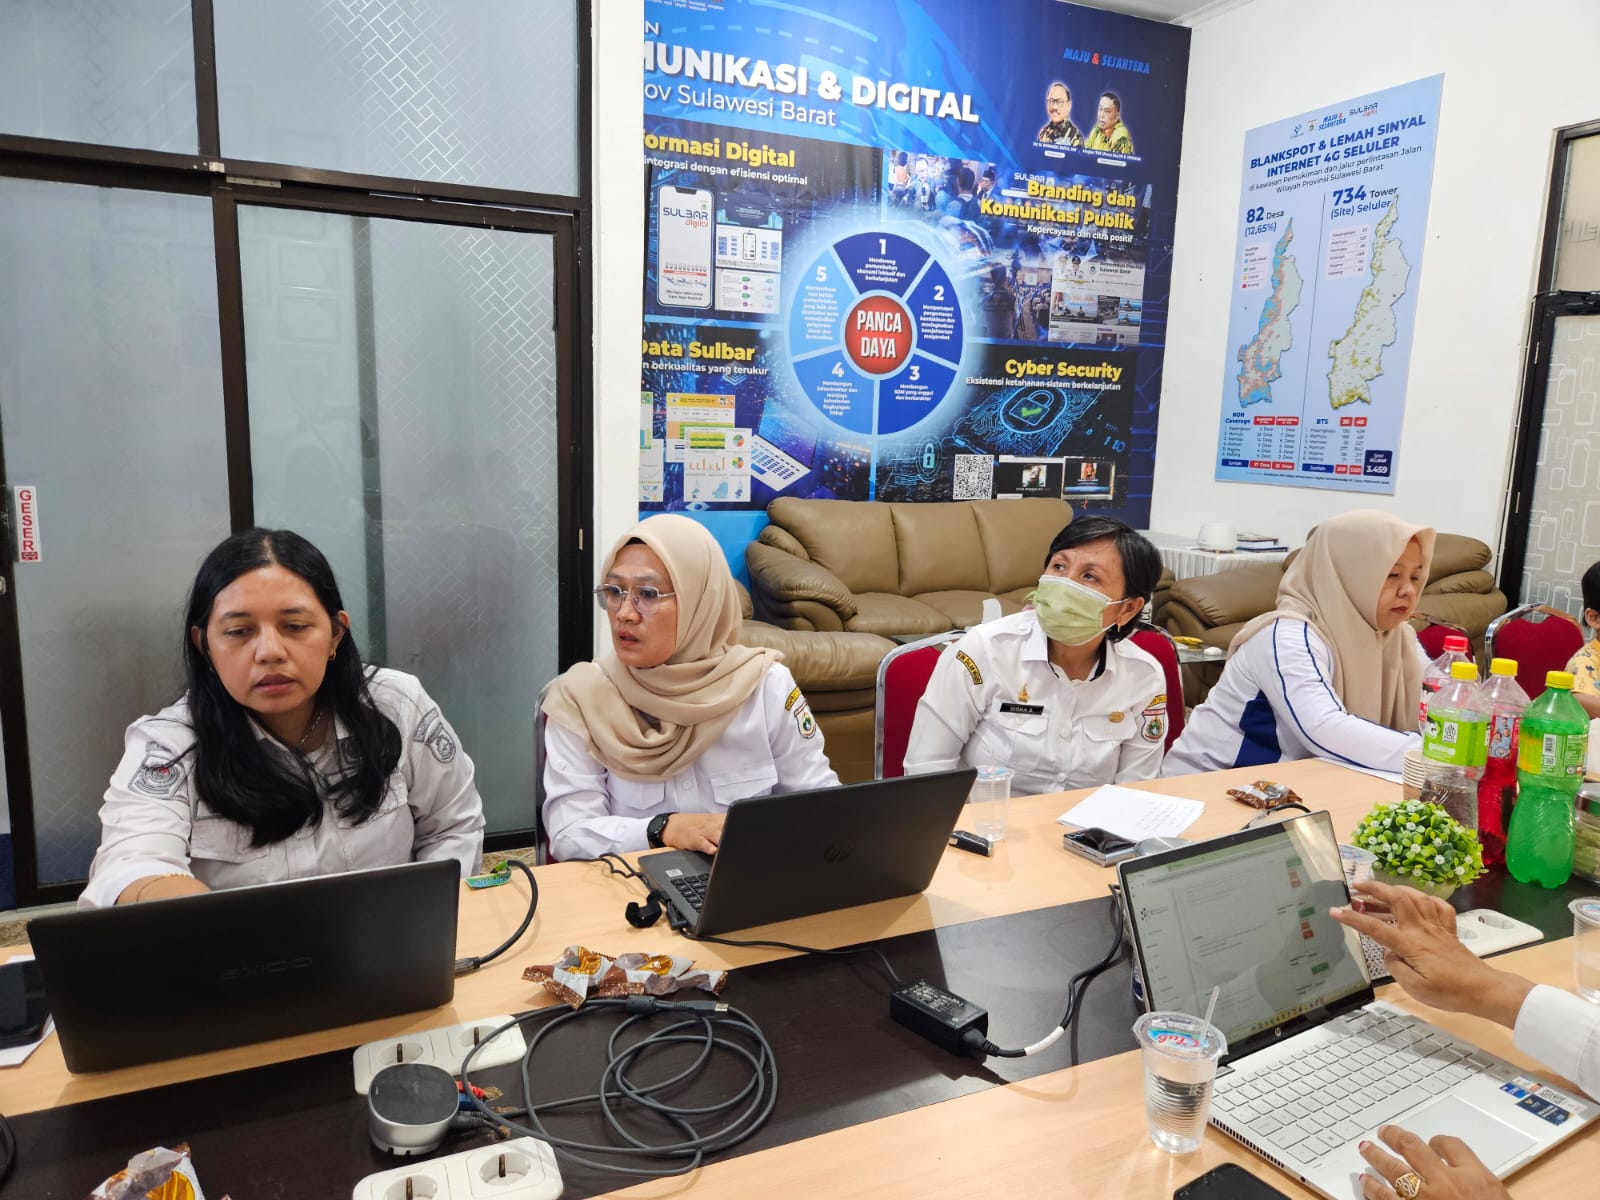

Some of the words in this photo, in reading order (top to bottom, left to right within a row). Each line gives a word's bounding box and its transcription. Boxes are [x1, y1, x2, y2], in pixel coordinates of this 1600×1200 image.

[644, 21, 660, 35] N
[1063, 48, 1090, 63] MAJU
[1091, 53, 1100, 65] &
[1101, 55, 1150, 75] SEJAHTERA
[644, 84, 671, 101] ov
[677, 85, 773, 117] Sulawesi
[782, 101, 836, 126] Barat
[817, 71, 842, 101] &
[852, 76, 979, 123] DIGITAL
[1250, 140, 1314, 169] BLANKSPOT
[1318, 139, 1326, 150] &
[1330, 127, 1374, 147] LEMAH
[1377, 114, 1426, 136] SINYAL
[726, 142, 796, 168] Digital
[1266, 155, 1321, 178] INTERNET
[1323, 151, 1340, 164] 4G
[1343, 136, 1400, 159] SELULER
[1284, 168, 1322, 184] Pemukiman
[1324, 164, 1337, 174] dan
[1400, 145, 1422, 157] Jalan
[690, 161, 728, 175] dengan
[731, 166, 770, 181] efisiensi
[772, 171, 808, 185] optimal
[1276, 182, 1301, 194] Wilayah
[1302, 176, 1329, 189] Provinsi
[1330, 168, 1362, 181] Sulawesi
[1363, 163, 1384, 174] Barat
[1028, 180, 1103, 207] Branding
[1107, 190, 1136, 208] dan
[1332, 184, 1367, 206] 734
[1370, 185, 1398, 199] Tower
[980, 198, 1079, 225] Komunikasi
[1083, 210, 1135, 230] Publik
[1246, 207, 1264, 223] 82
[1266, 210, 1285, 219] Desa
[1330, 204, 1354, 220] (Site)
[1357, 199, 1391, 214] Seluler
[1027, 224, 1075, 237] Kepercayaan
[1077, 230, 1091, 239] dan
[1093, 231, 1109, 241] citra
[1110, 234, 1133, 244] positif
[879, 239, 887, 255] 1
[816, 266, 827, 282] 5
[934, 286, 944, 301] 2
[857, 310, 902, 333] PANCA
[689, 341, 755, 361] Sulbar
[861, 337, 896, 358] DAYA
[653, 361, 706, 372] berkualitas
[708, 365, 731, 375] yang
[734, 366, 768, 375] terukur
[831, 362, 844, 377] 4
[909, 366, 920, 380] 3
[1005, 359, 1053, 378] Cyber
[1057, 362, 1122, 382] Security
[966, 377, 1004, 386] Eksistensi
[1005, 378, 1045, 387] ketahanan
[1047, 380, 1070, 389] sistem
[1072, 381, 1120, 391] berkelanjutan
[19, 489, 34, 551] GESER
